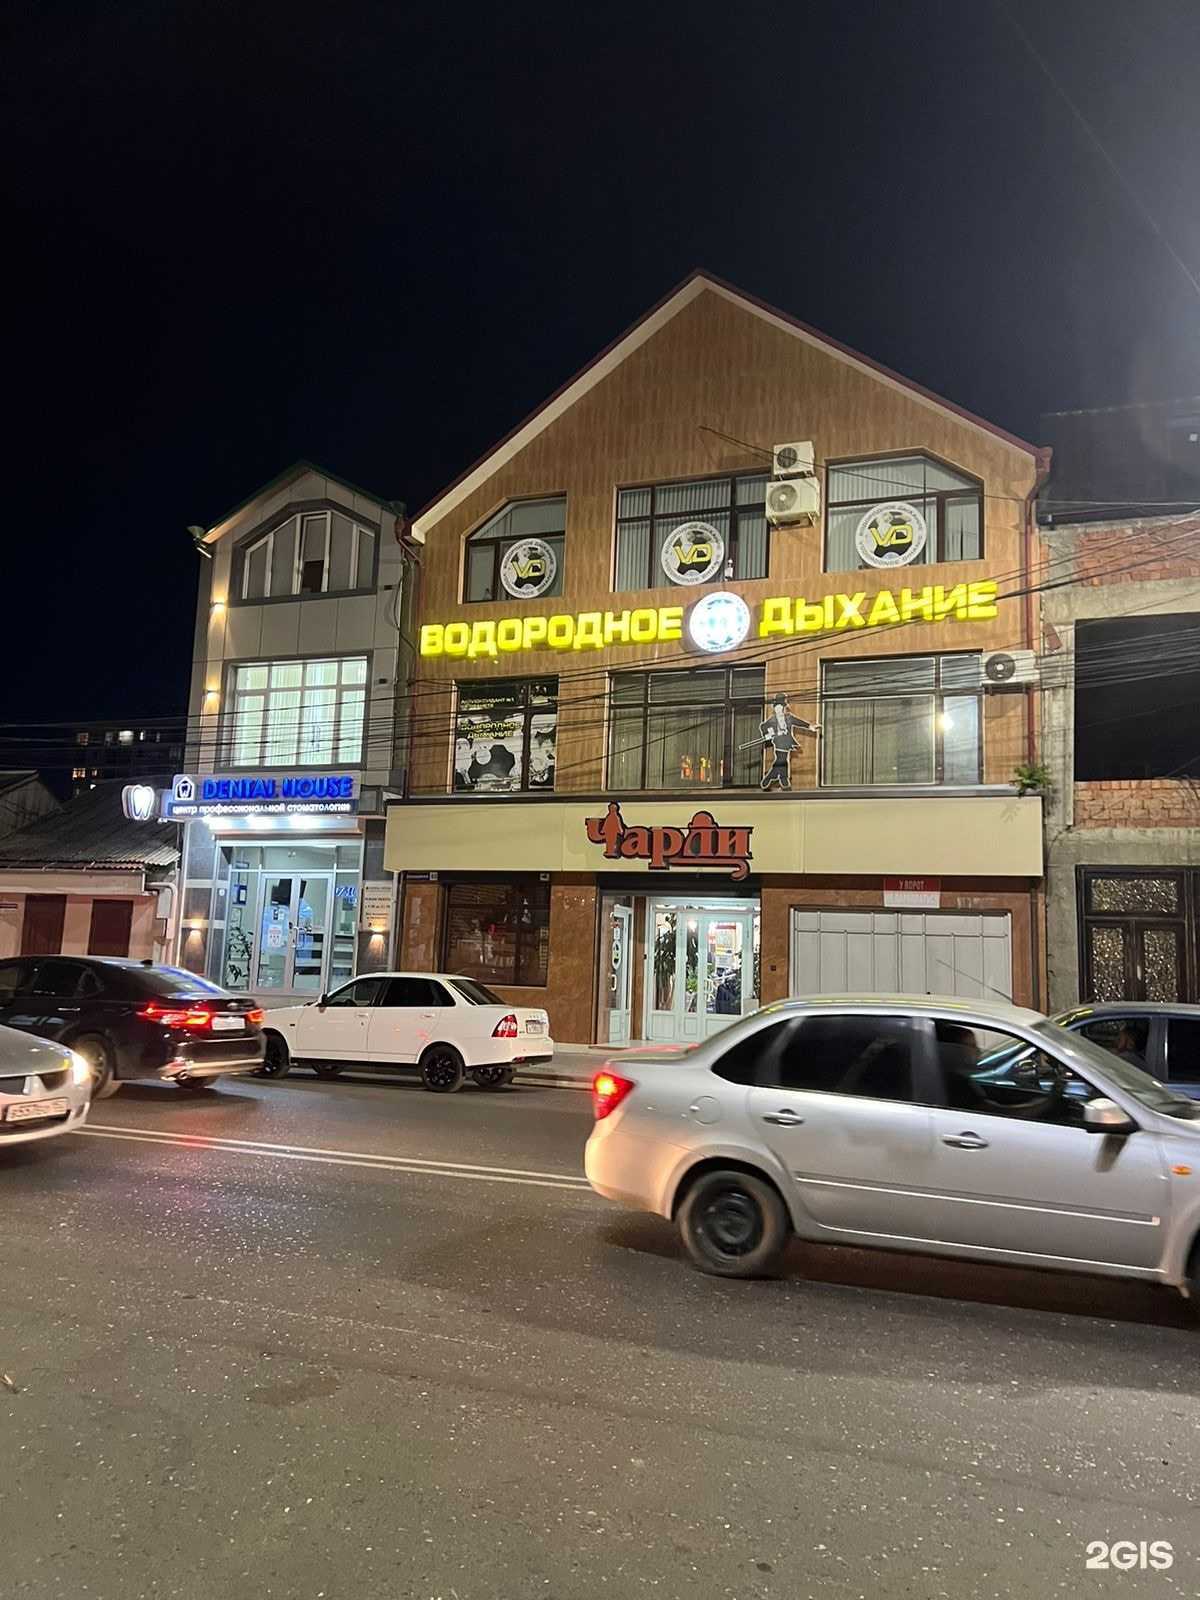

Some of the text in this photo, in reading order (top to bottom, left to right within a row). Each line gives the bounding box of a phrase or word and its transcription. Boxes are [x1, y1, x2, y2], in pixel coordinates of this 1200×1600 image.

[420, 607, 684, 657] ВОДОРОДНОЕ
[759, 580, 998, 637] ДЫХАНИЕ
[203, 776, 353, 800] DENTAL HOUSE
[585, 801, 753, 880] Чарли
